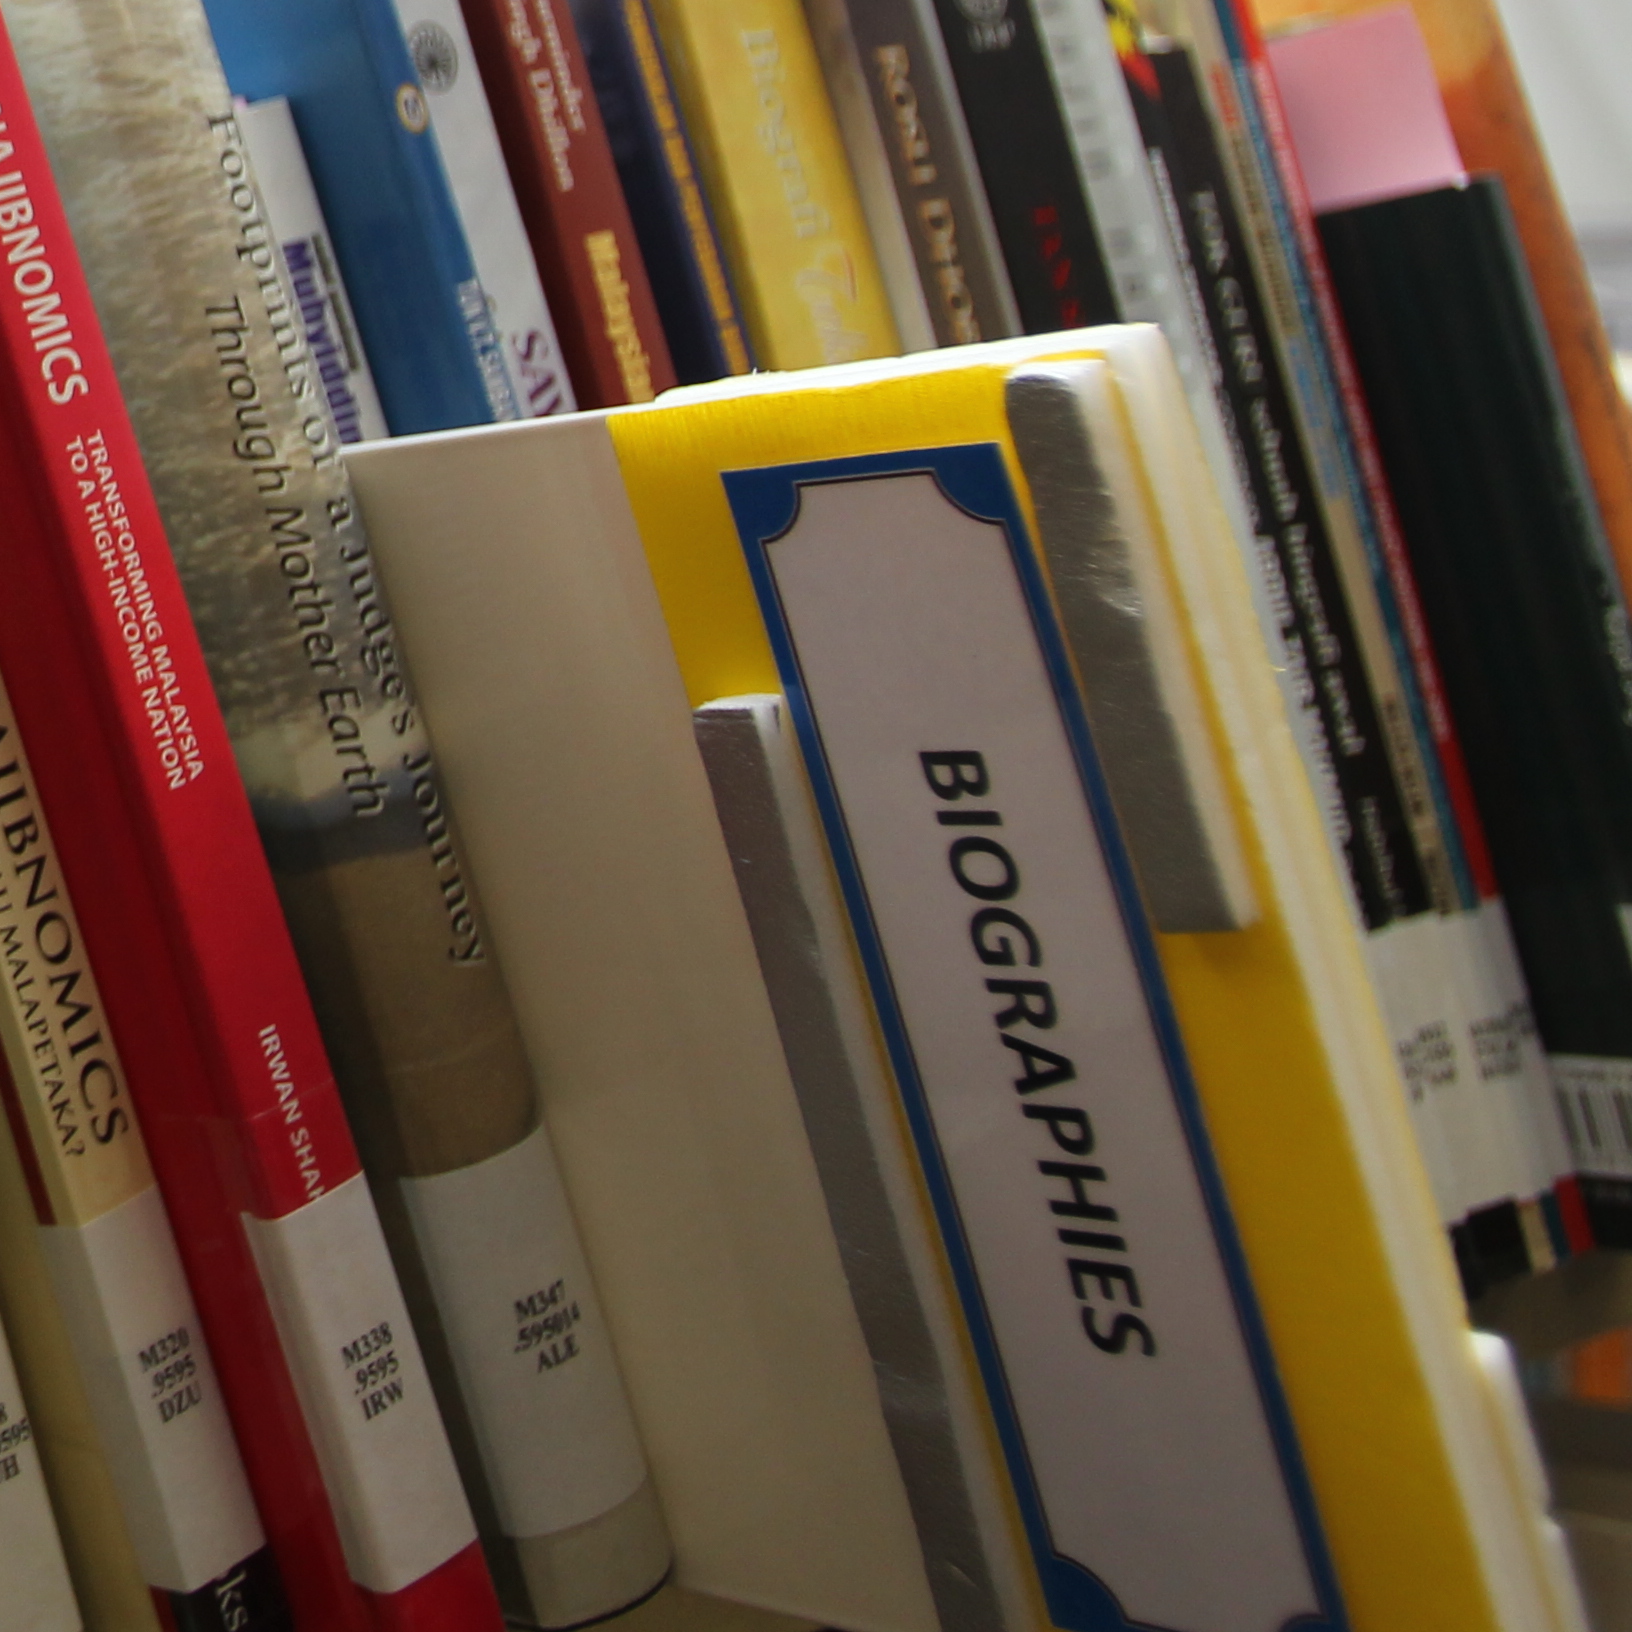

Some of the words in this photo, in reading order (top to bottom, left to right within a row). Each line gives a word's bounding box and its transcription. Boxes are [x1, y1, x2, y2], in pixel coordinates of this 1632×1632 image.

[66, 436, 90, 475] TO
[78, 479, 97, 500] A
[207, 296, 291, 493] Through
[266, 507, 336, 669] Mother
[318, 686, 388, 817] Earth
[86, 502, 153, 686] HIGH-INCOME
[86, 428, 161, 644] TRANSFORMING
[151, 647, 203, 781] MALAYSIA
[143, 689, 186, 790] NATION
[403, 751, 486, 965] Journey
[259, 1024, 302, 1124] IRWAN
[920, 750, 1154, 1358] BIOGRAPHIES
[139, 1328, 189, 1372] M320
[342, 1322, 393, 1369] M338
[537, 1335, 580, 1374] ALE
[151, 1355, 197, 1399] .9595
[354, 1354, 399, 1396] .9595
[157, 1381, 202, 1424] DZU
[361, 1378, 404, 1421] IRW
